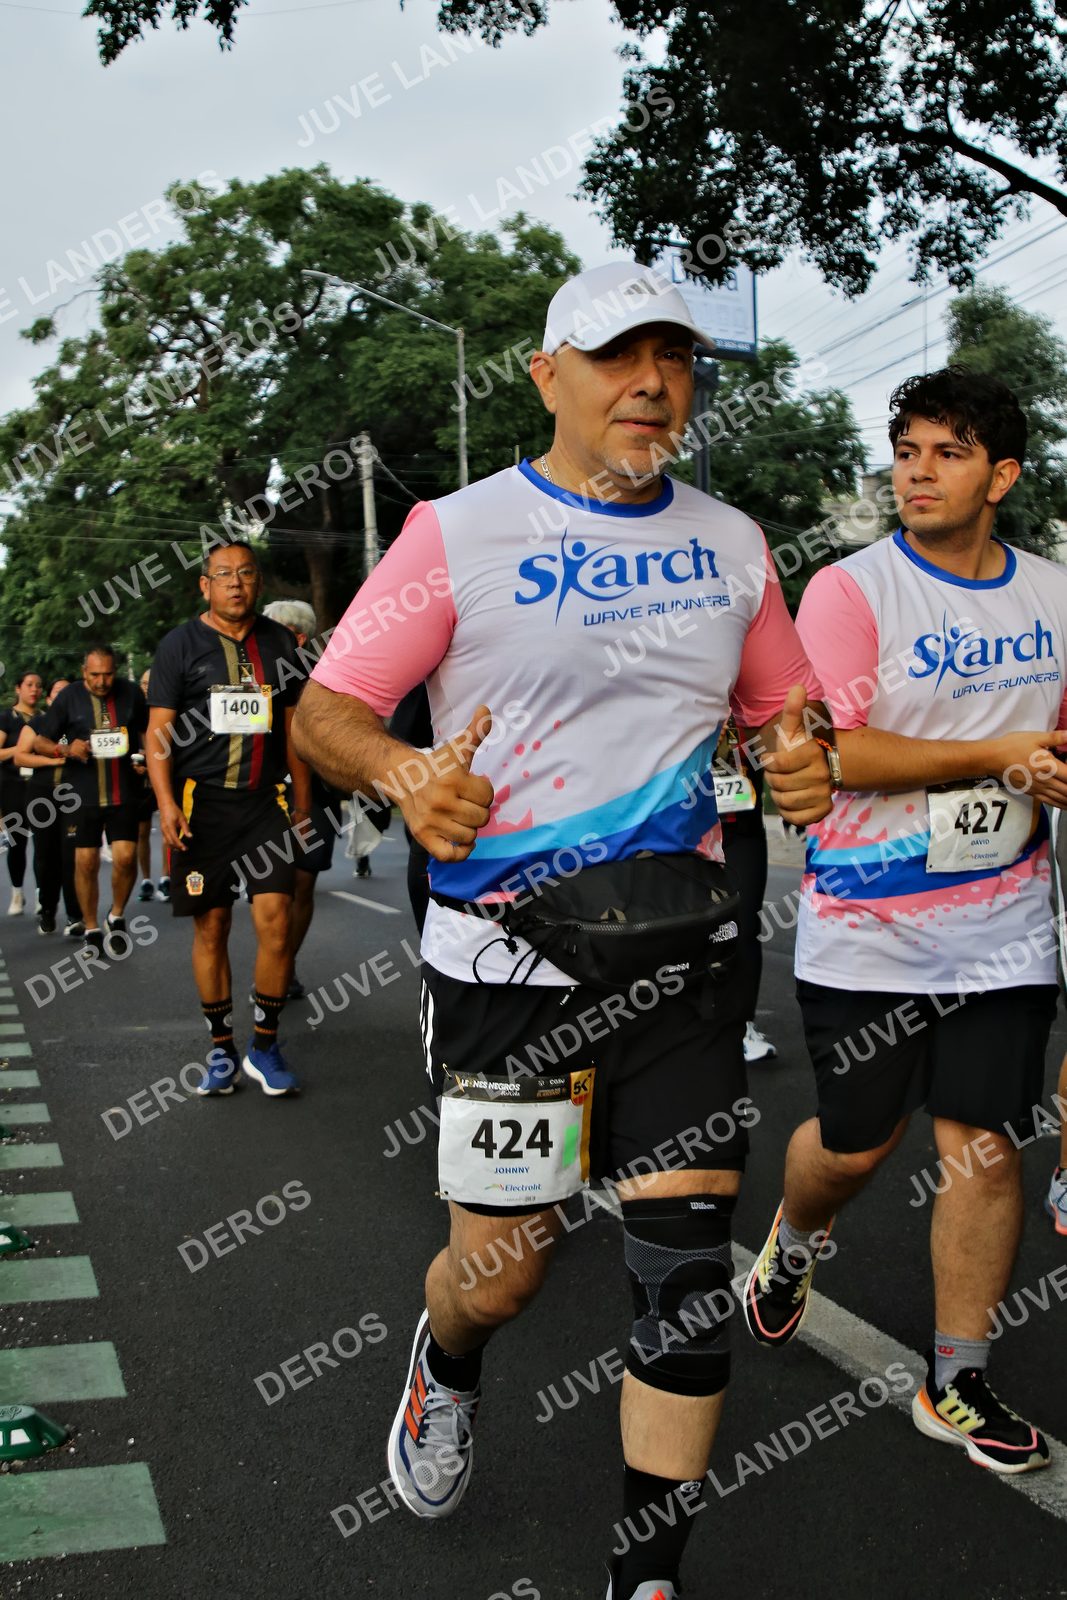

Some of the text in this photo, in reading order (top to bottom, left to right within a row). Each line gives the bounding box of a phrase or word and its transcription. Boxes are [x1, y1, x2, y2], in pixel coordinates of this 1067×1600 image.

[583, 595, 731, 626] WAVE RUNNERS
[952, 672, 1060, 699] WAVE RUNNERS
[221, 699, 259, 715] 1400
[97, 737, 121, 747] 5594
[955, 800, 1008, 835] 427
[471, 1119, 553, 1159] 424
